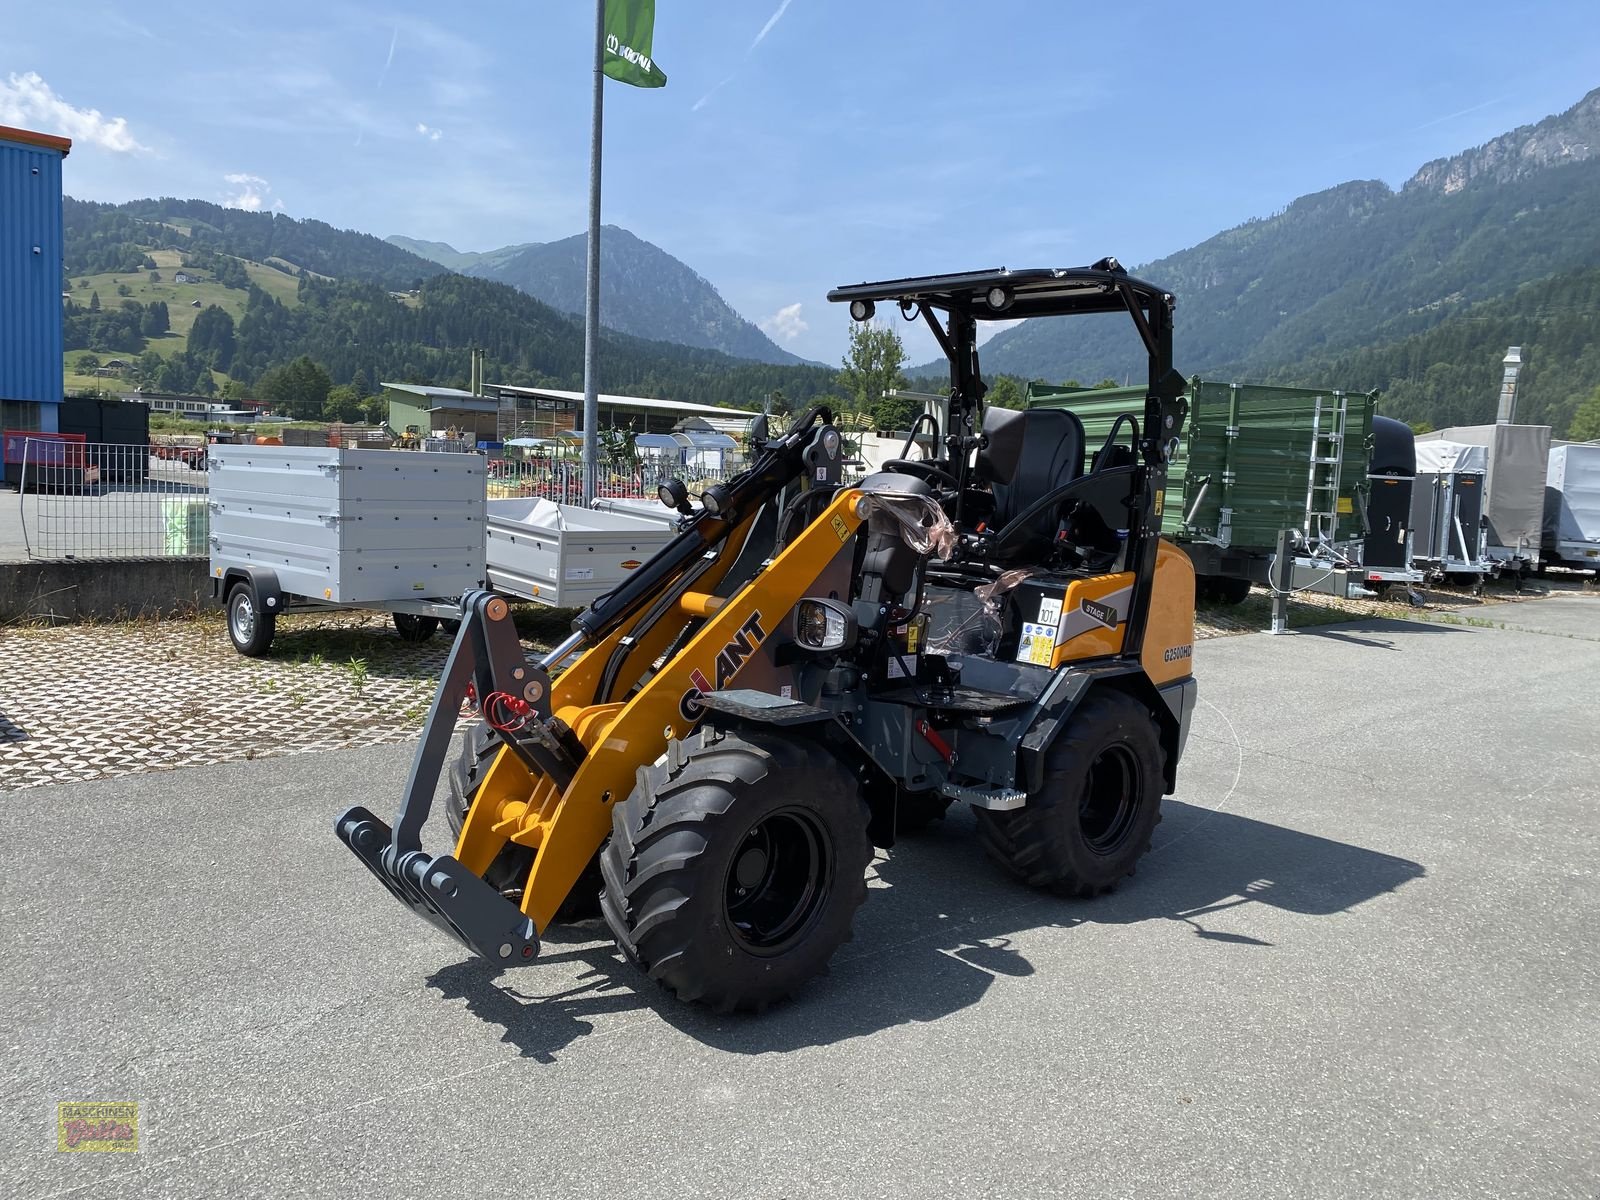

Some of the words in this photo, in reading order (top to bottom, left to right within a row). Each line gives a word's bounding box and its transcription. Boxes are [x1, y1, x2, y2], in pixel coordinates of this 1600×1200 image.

[1040, 609, 1054, 623] 101
[1086, 604, 1105, 620] STAGE
[1164, 644, 1192, 663] G2500HD
[679, 608, 767, 722] GIANT
